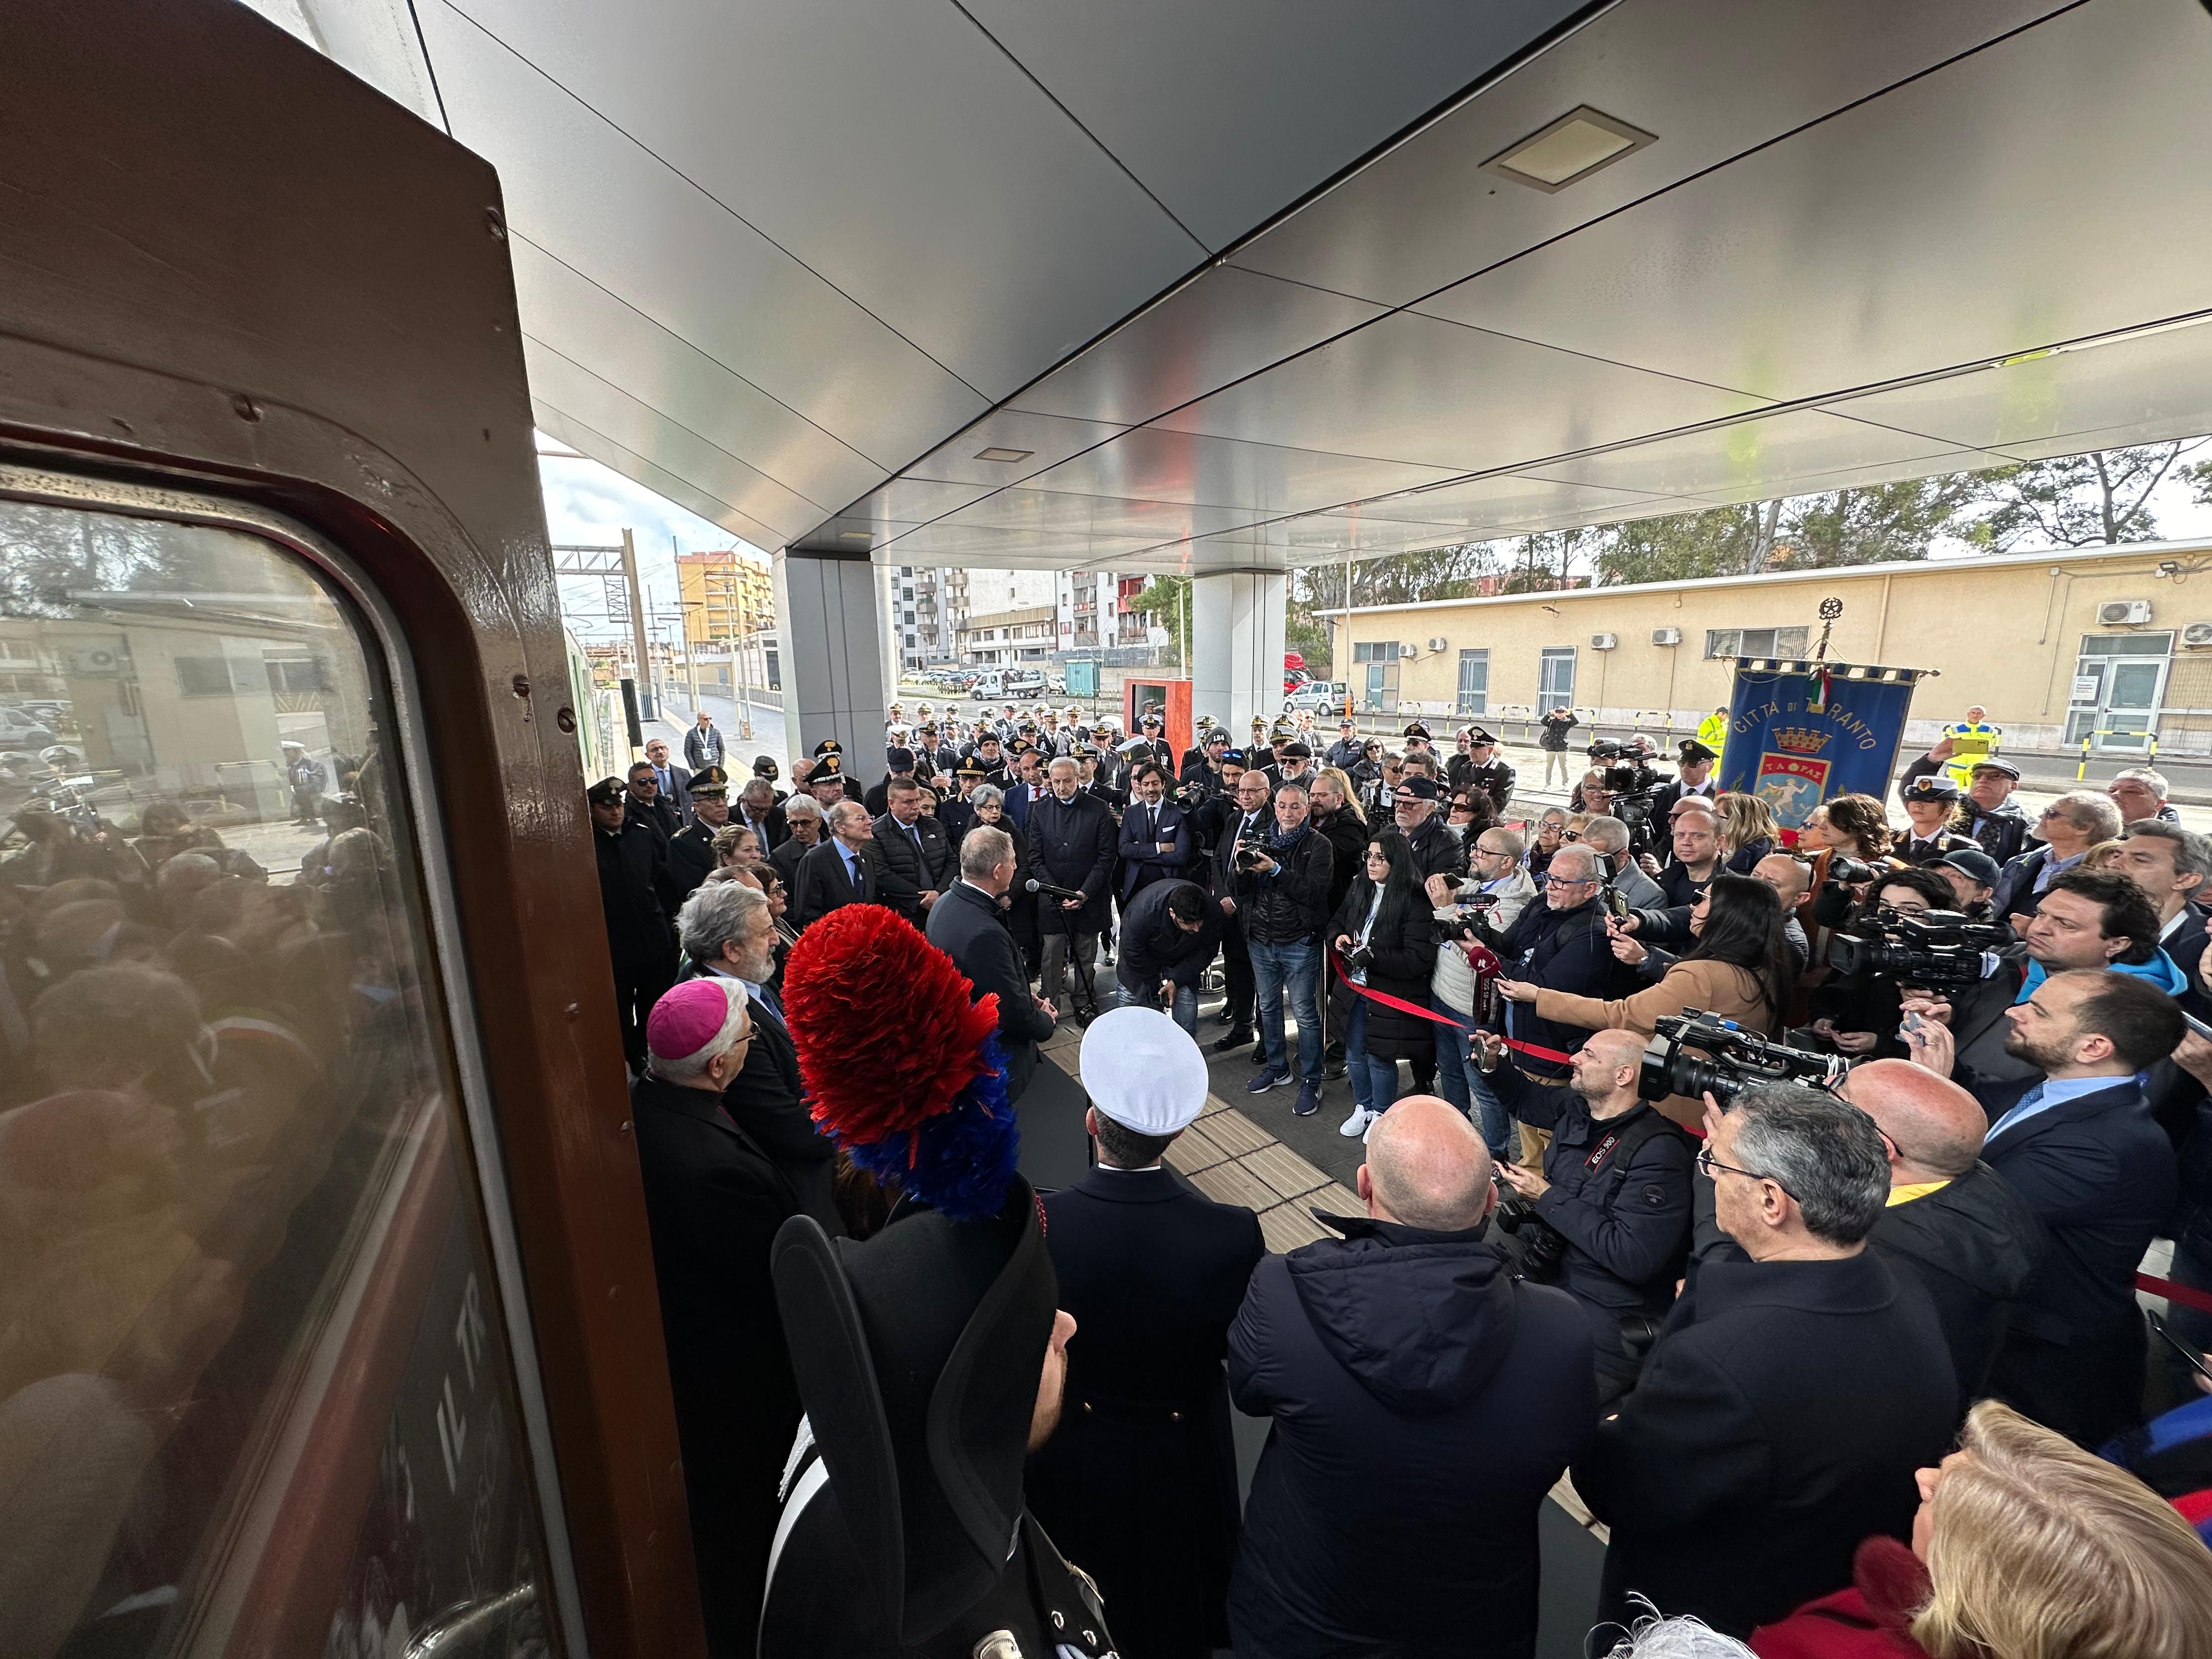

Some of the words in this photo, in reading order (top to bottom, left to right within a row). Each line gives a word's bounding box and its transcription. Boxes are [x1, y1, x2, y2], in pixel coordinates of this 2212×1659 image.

[1734, 698, 1780, 733] CITTÀ
[1787, 702, 1797, 712] DI
[1805, 697, 1876, 749] TRANTO
[1592, 1147, 1606, 1164] EOS
[1603, 1137, 1615, 1149] 90D
[437, 1372, 466, 1496] IL
